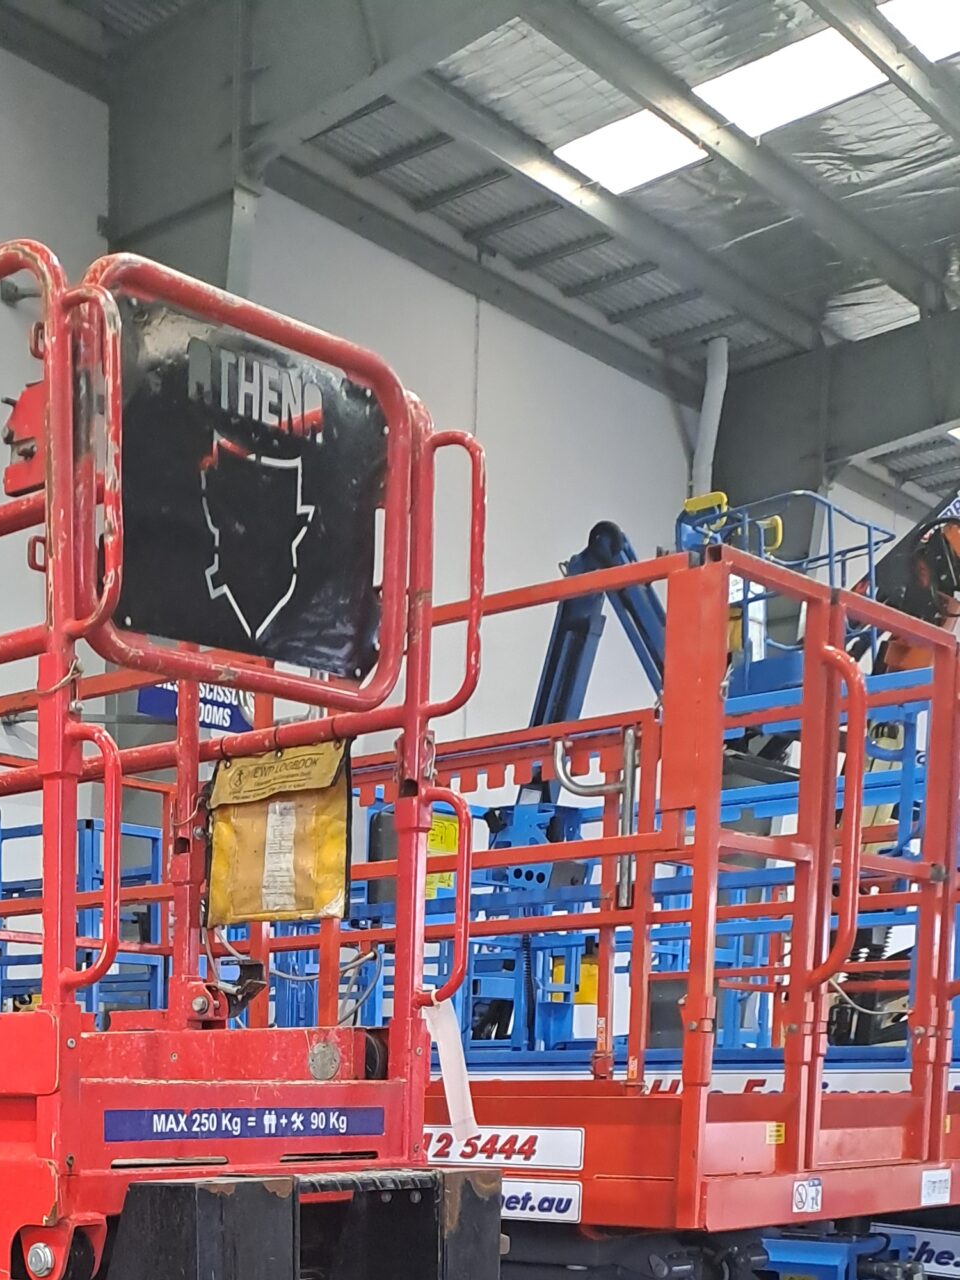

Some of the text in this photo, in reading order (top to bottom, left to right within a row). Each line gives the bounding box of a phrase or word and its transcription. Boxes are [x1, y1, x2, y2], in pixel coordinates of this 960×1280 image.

[152, 1113, 188, 1133] MAX
[191, 1112, 217, 1132] 250
[221, 1112, 241, 1136] Kg
[310, 1111, 326, 1130] 90
[329, 1111, 348, 1134] Kg
[459, 1133, 539, 1161] 5444
